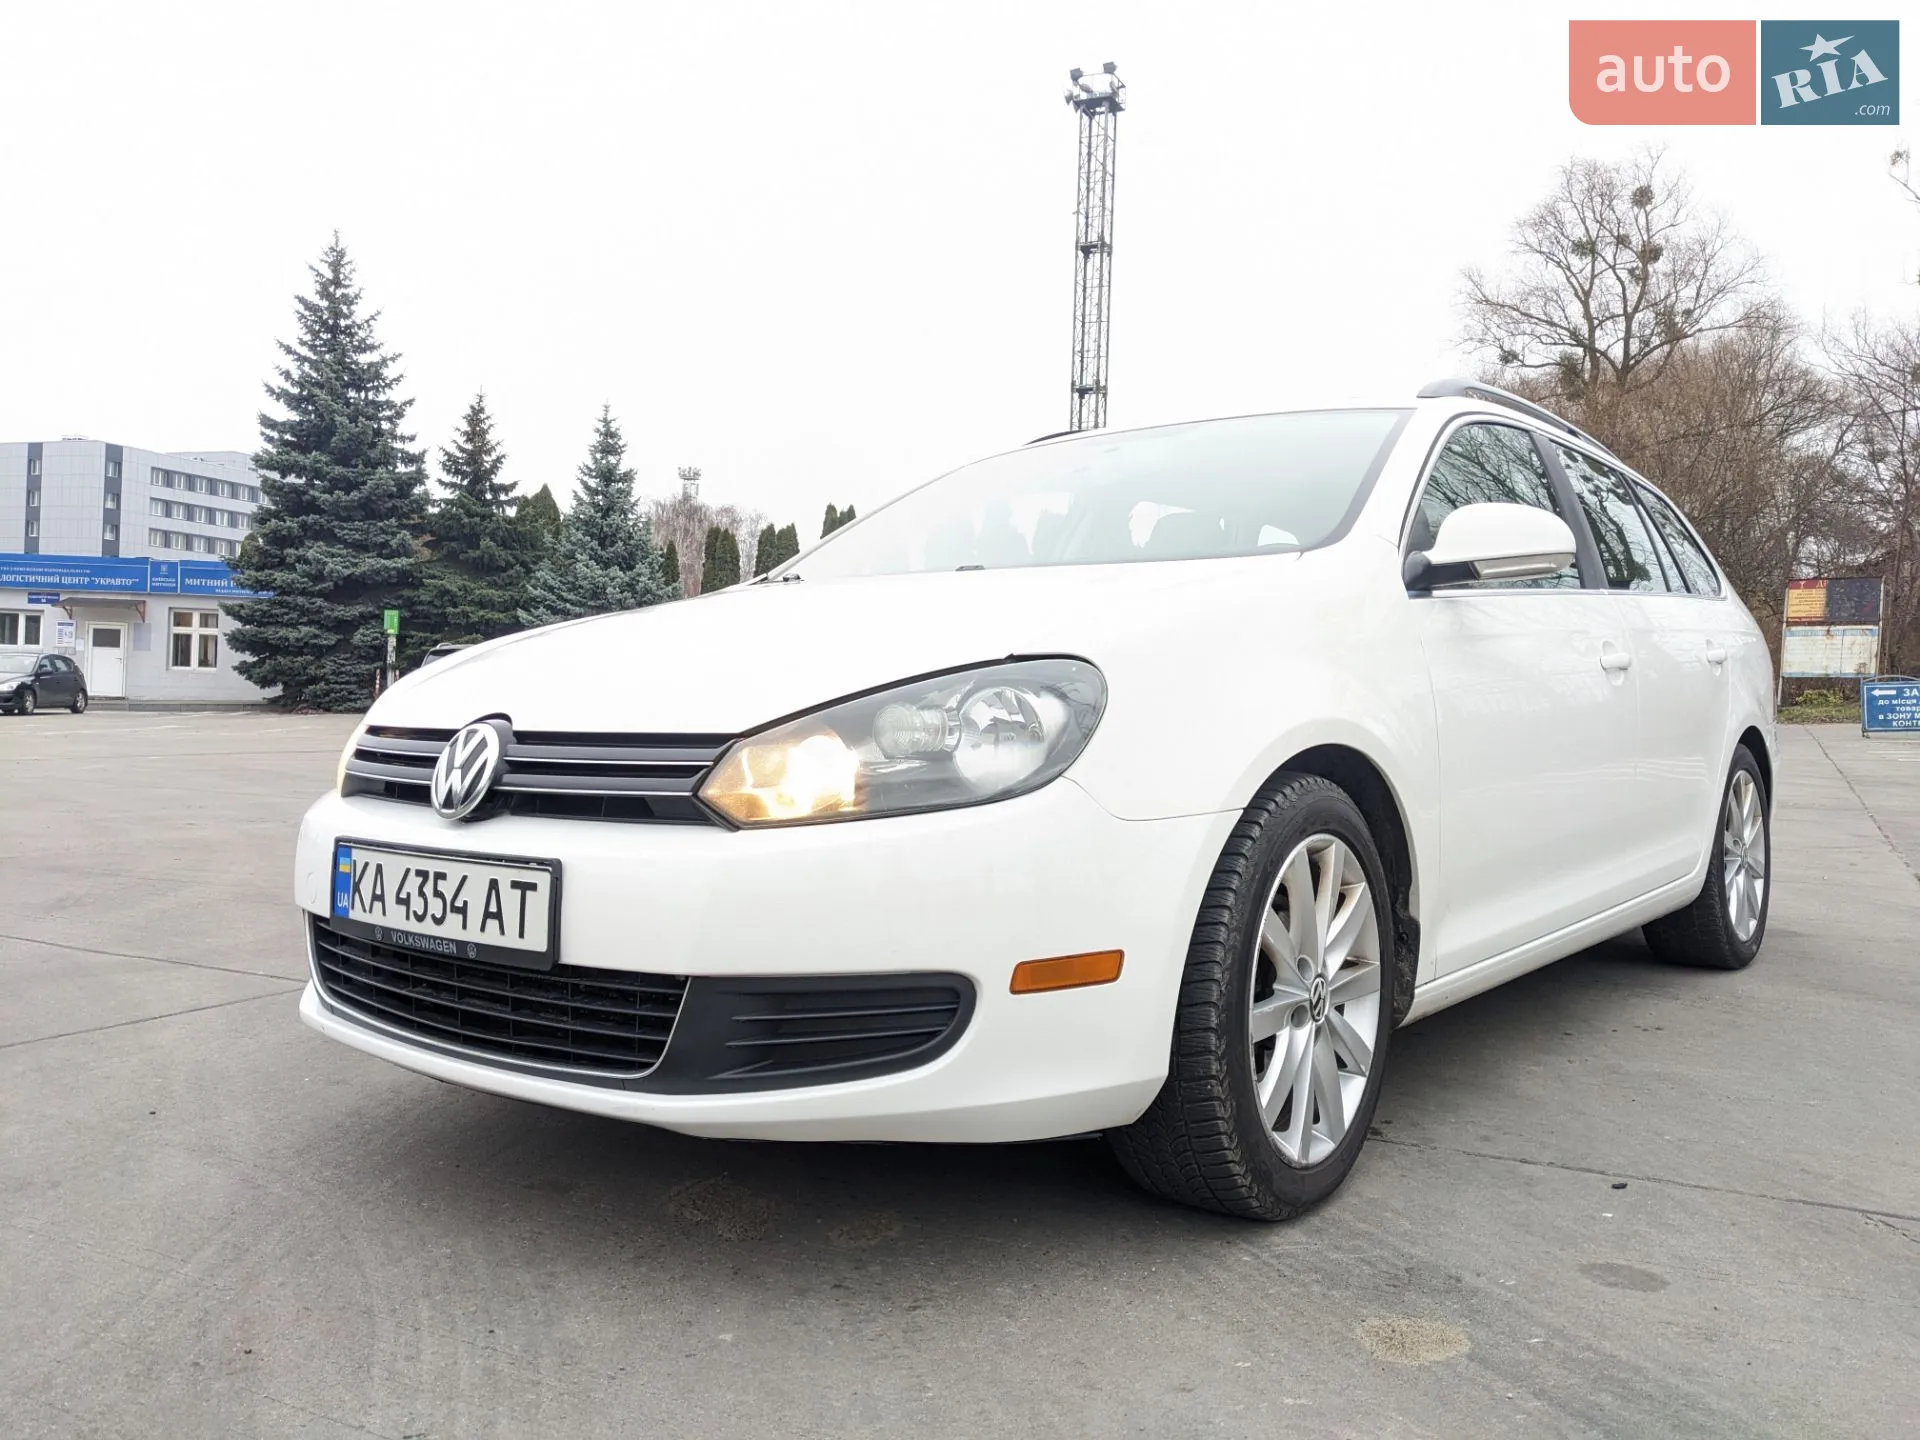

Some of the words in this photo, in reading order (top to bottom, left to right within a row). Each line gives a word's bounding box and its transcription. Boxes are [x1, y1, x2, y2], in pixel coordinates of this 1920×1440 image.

[0, 574, 60, 584] ЛОГІСТИЧНИЙ
[61, 576, 89, 585] ЦЕНТР
[184, 578, 228, 588] МИТНИЙ
[1886, 712, 1912, 720] ЗОНУ
[337, 891, 348, 908] UA
[351, 859, 387, 917] KA
[395, 867, 469, 931] 4354
[480, 877, 538, 939] AT
[390, 930, 457, 954] VOLKSWAGEN
